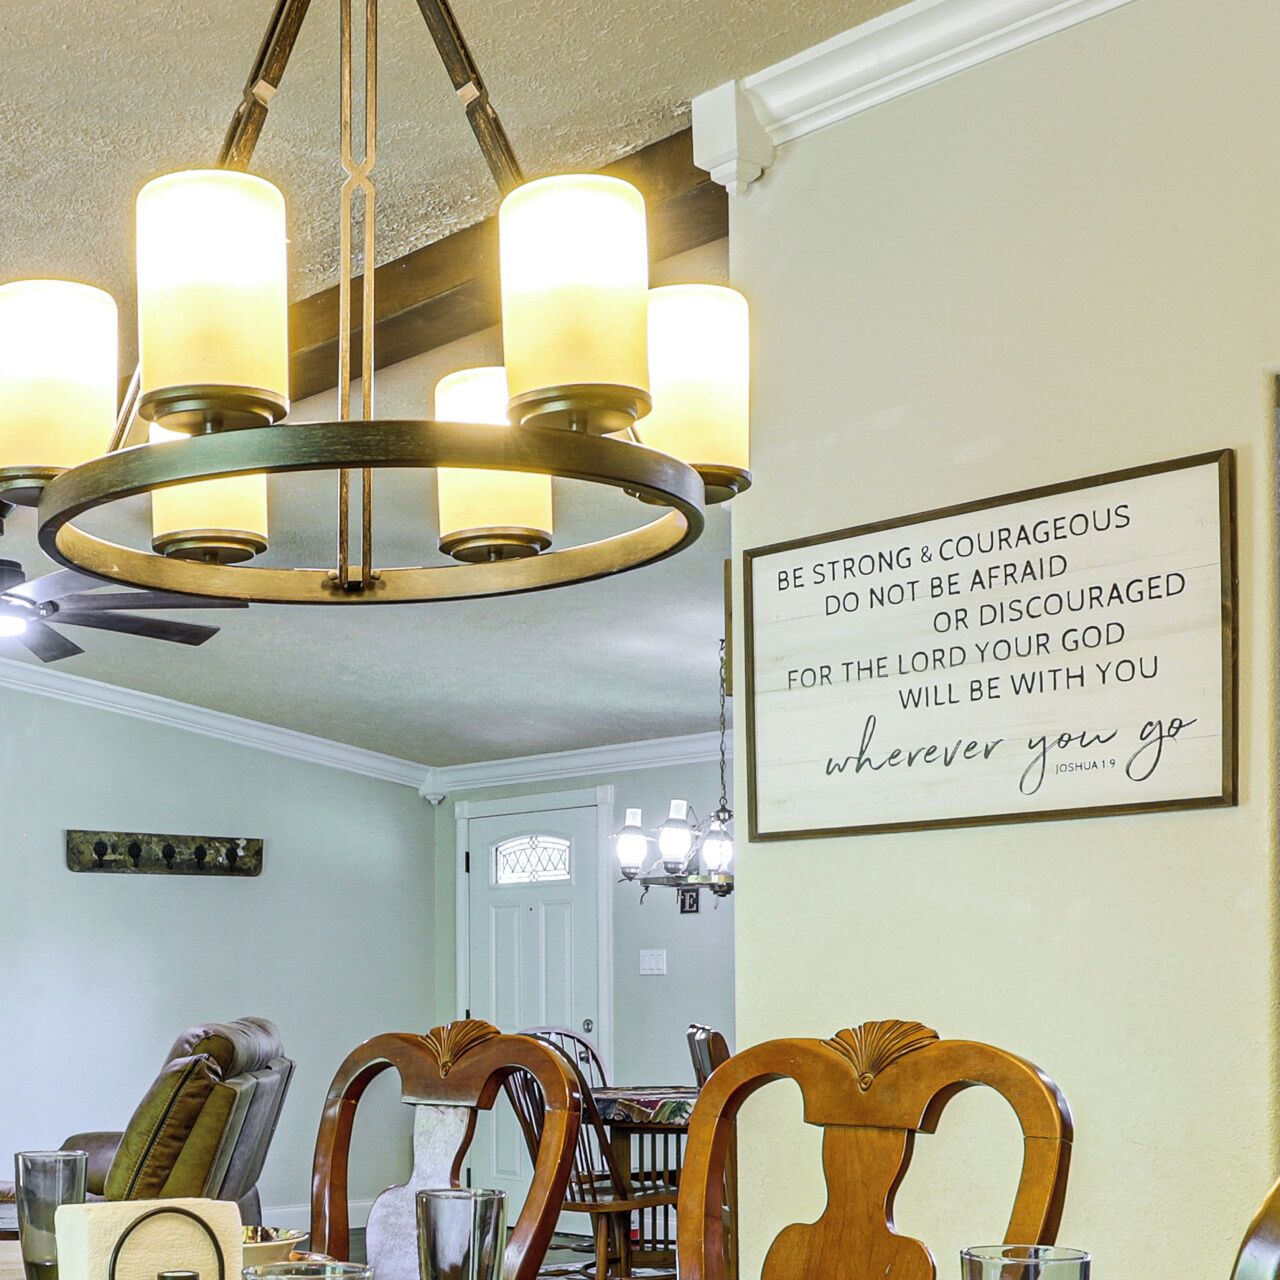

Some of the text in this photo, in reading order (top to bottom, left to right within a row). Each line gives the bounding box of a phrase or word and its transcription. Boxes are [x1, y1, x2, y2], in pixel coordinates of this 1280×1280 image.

[778, 504, 1131, 591] BE STRONG & COURAGEOUS
[825, 554, 1068, 616] DO NOT BE AFRAID
[933, 572, 1186, 633] OR DISCOURAGED
[788, 622, 1126, 690] FOR THE LORD YOUR GOD
[899, 655, 1158, 710] WILL BE WITH YOU
[825, 714, 1199, 796] wherever you go
[1055, 761, 1098, 776] JOSHUA
[683, 892, 697, 911] E
